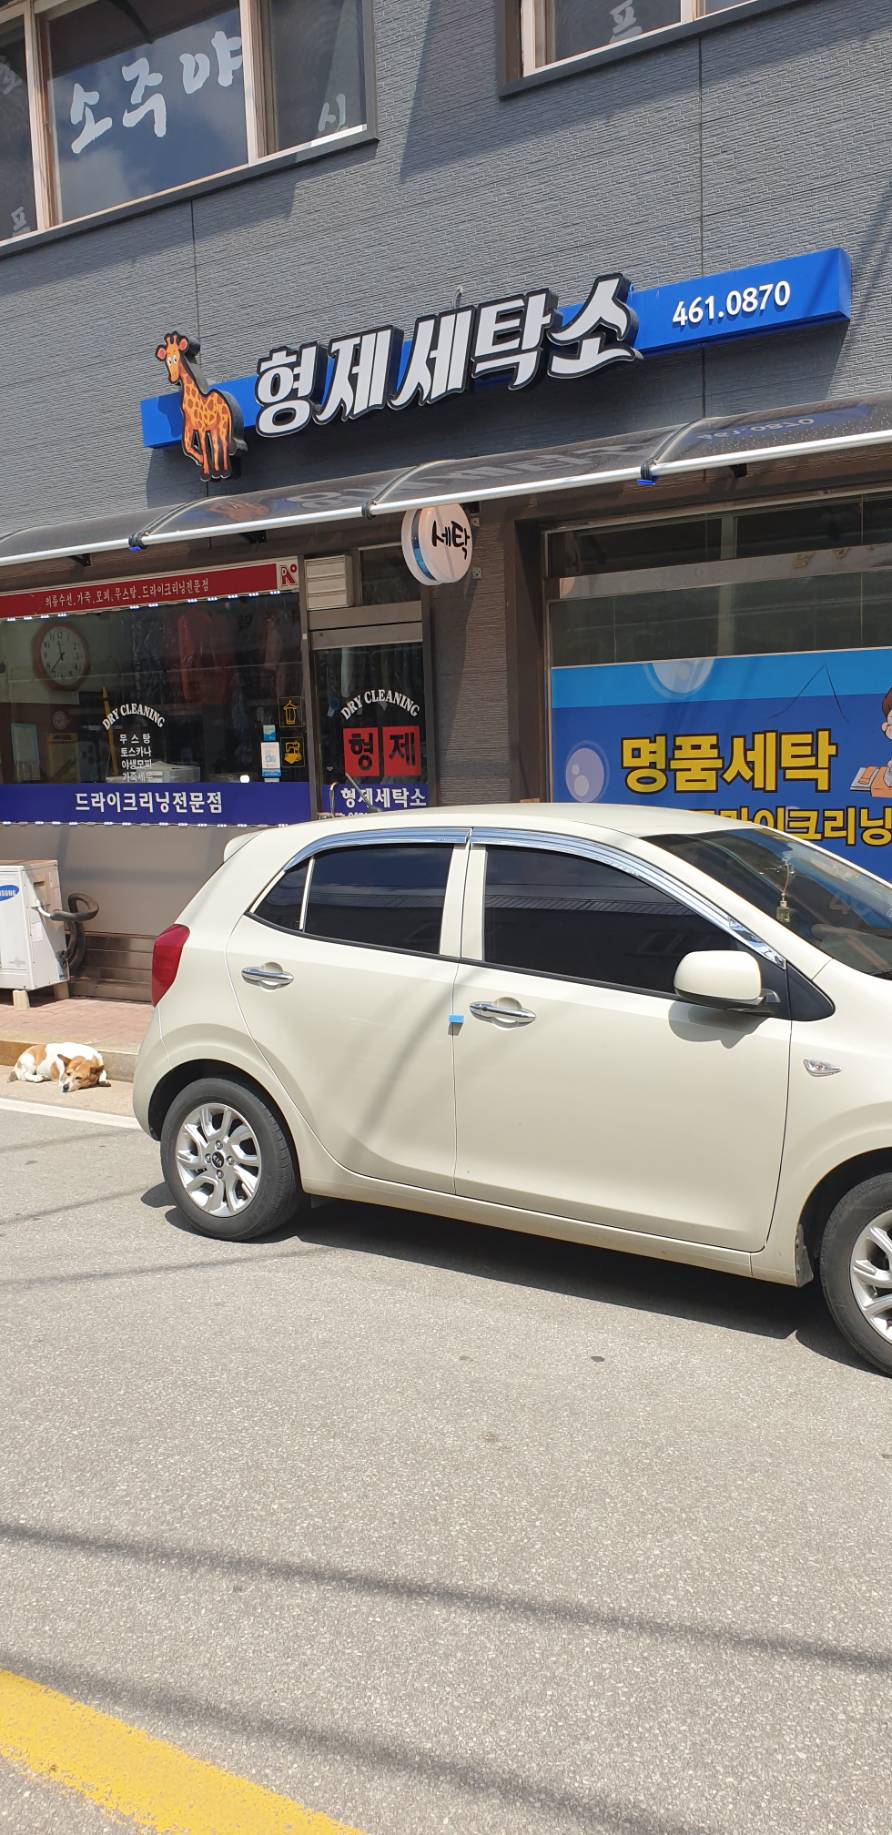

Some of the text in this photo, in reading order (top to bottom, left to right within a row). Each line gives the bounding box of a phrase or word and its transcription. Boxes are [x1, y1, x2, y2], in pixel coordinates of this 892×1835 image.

[672, 280, 791, 327] 461.0870
[255, 273, 640, 437] 형제세탁소
[432, 520, 470, 560] 세탁
[102, 703, 165, 730] DRY CLEANING
[341, 689, 420, 720] DRY CLEANING
[121, 746, 152, 757] 토스카나
[621, 729, 838, 794] 명품세탁
[75, 792, 222, 813] 드라이크리닝전문점
[340, 787, 427, 808] 형제세탁소
